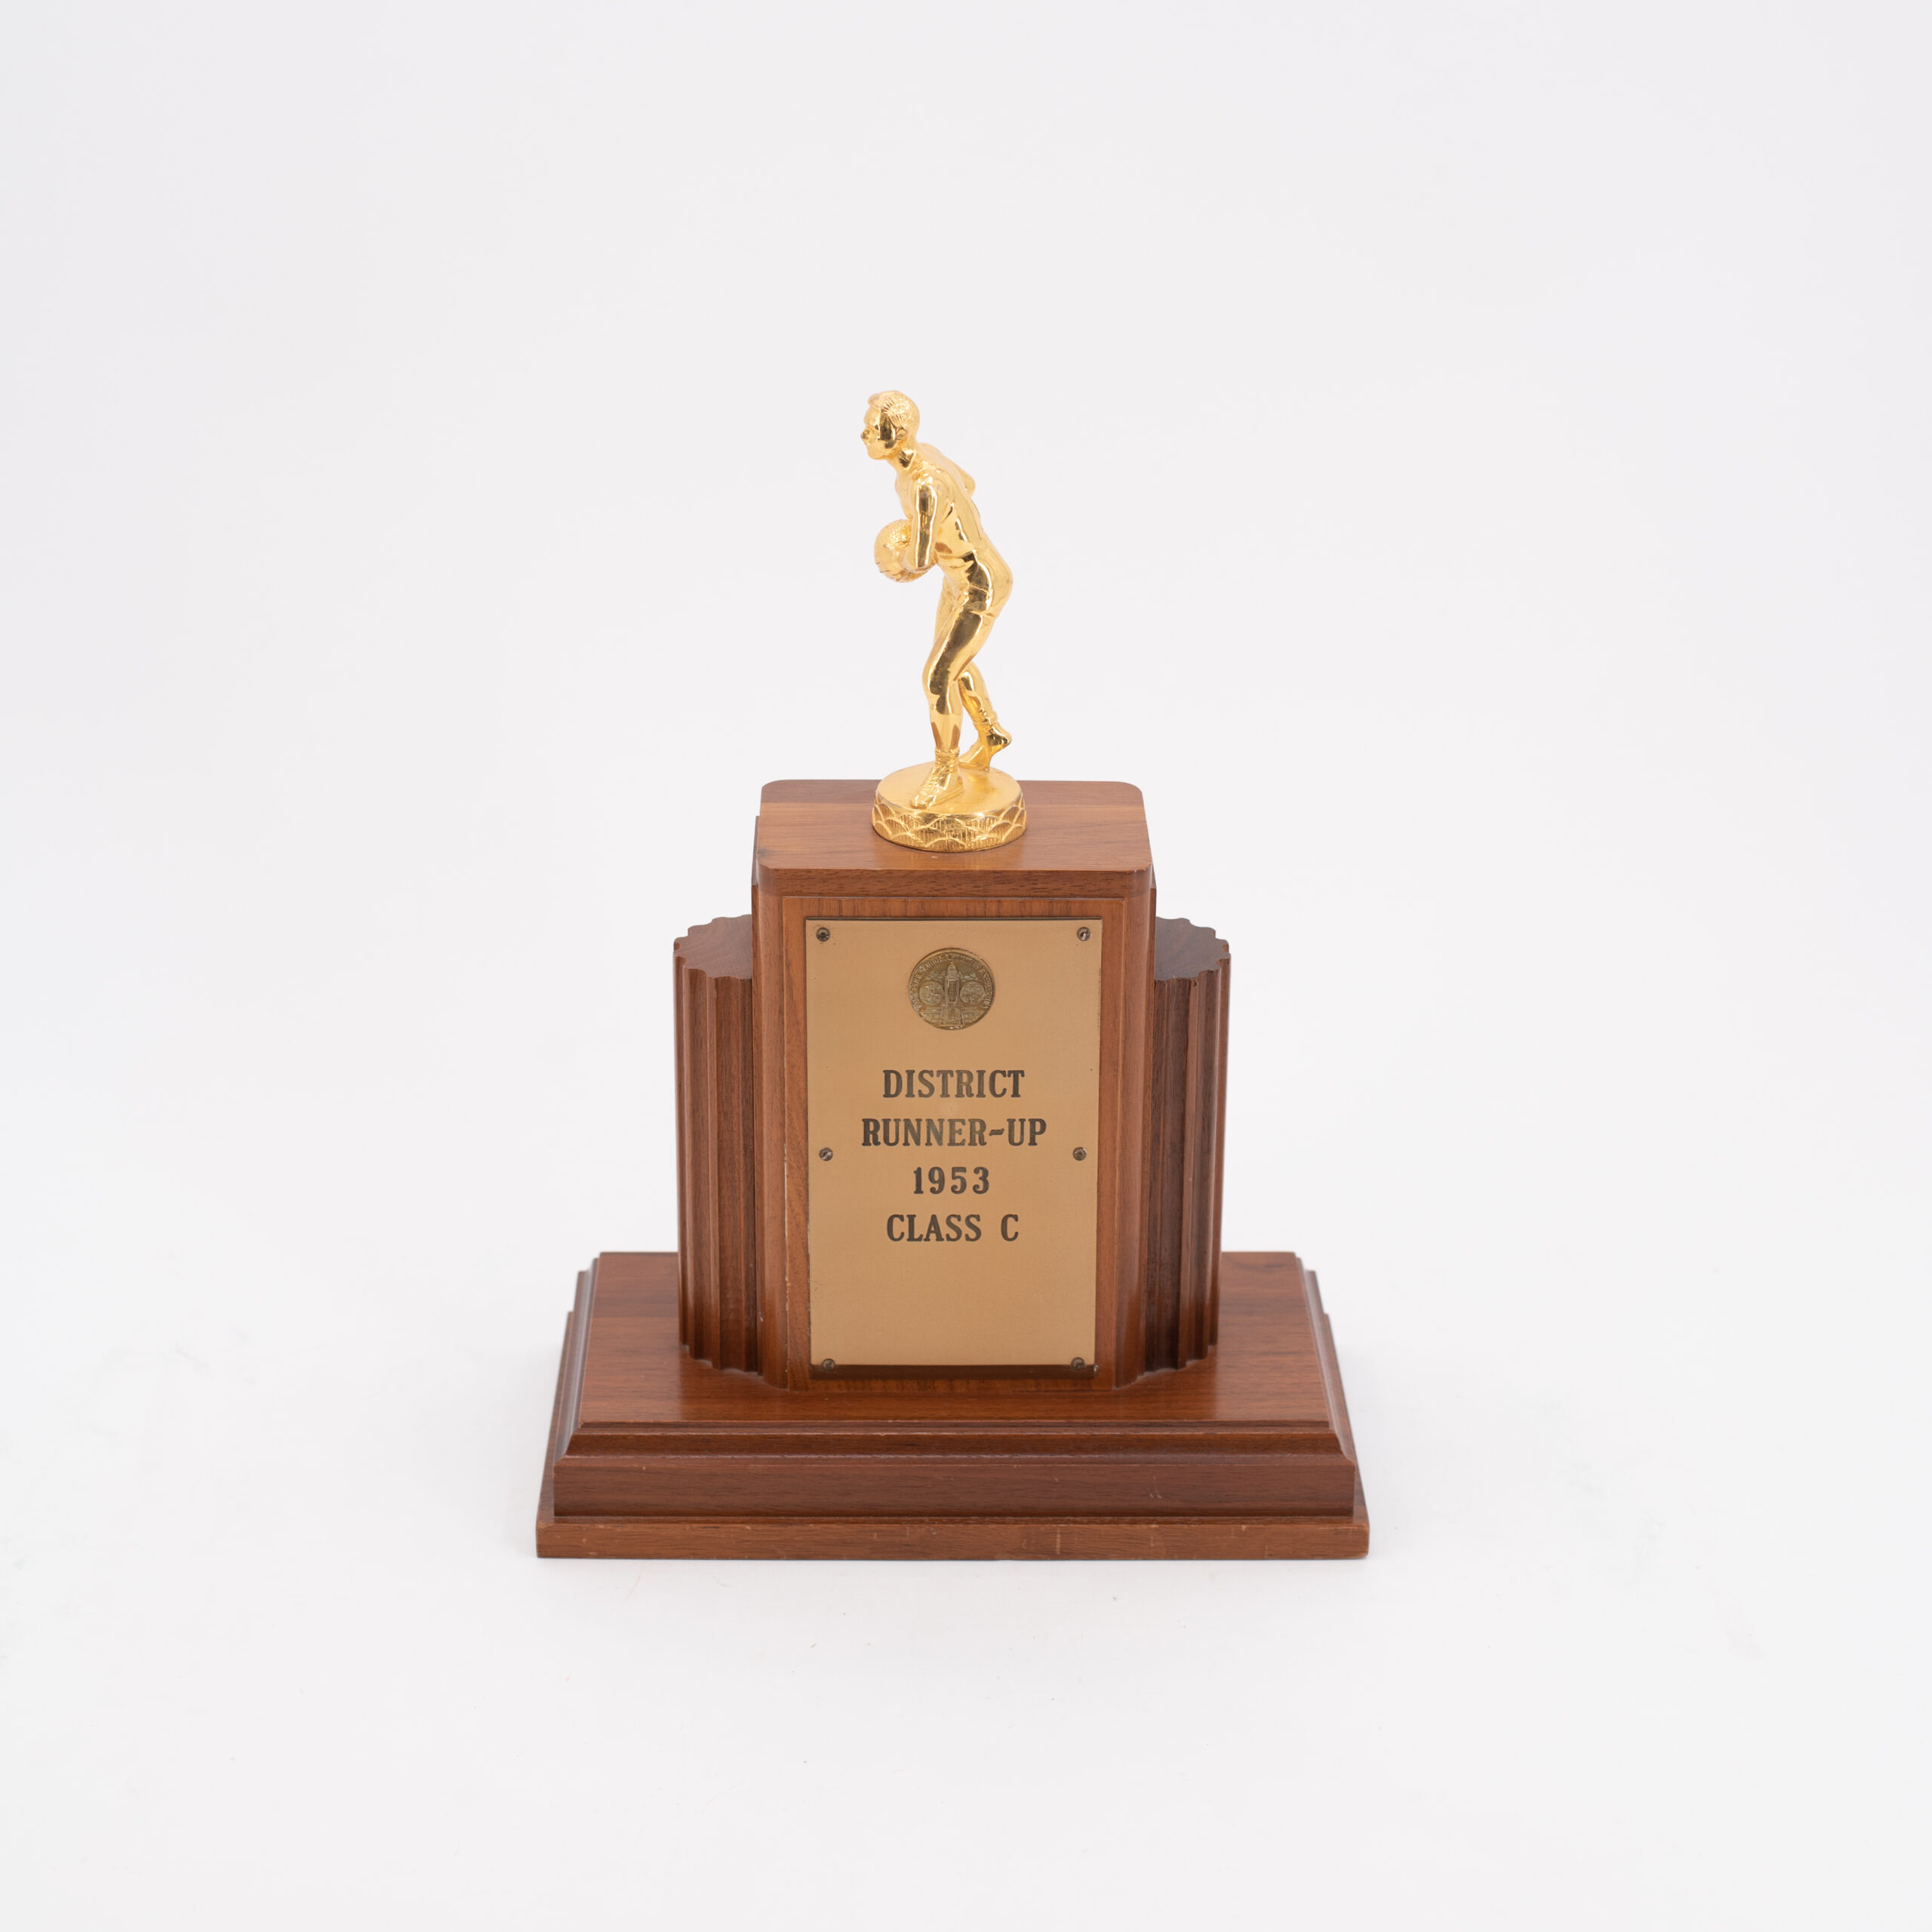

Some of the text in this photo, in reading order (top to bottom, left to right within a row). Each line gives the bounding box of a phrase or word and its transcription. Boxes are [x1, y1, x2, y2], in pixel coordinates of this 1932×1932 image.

[882, 1069, 1026, 1099] DISTRICT
[861, 1118, 1047, 1147] RUNNER-UP
[913, 1166, 990, 1195] 1953
[886, 1214, 1019, 1242] CLASS C
